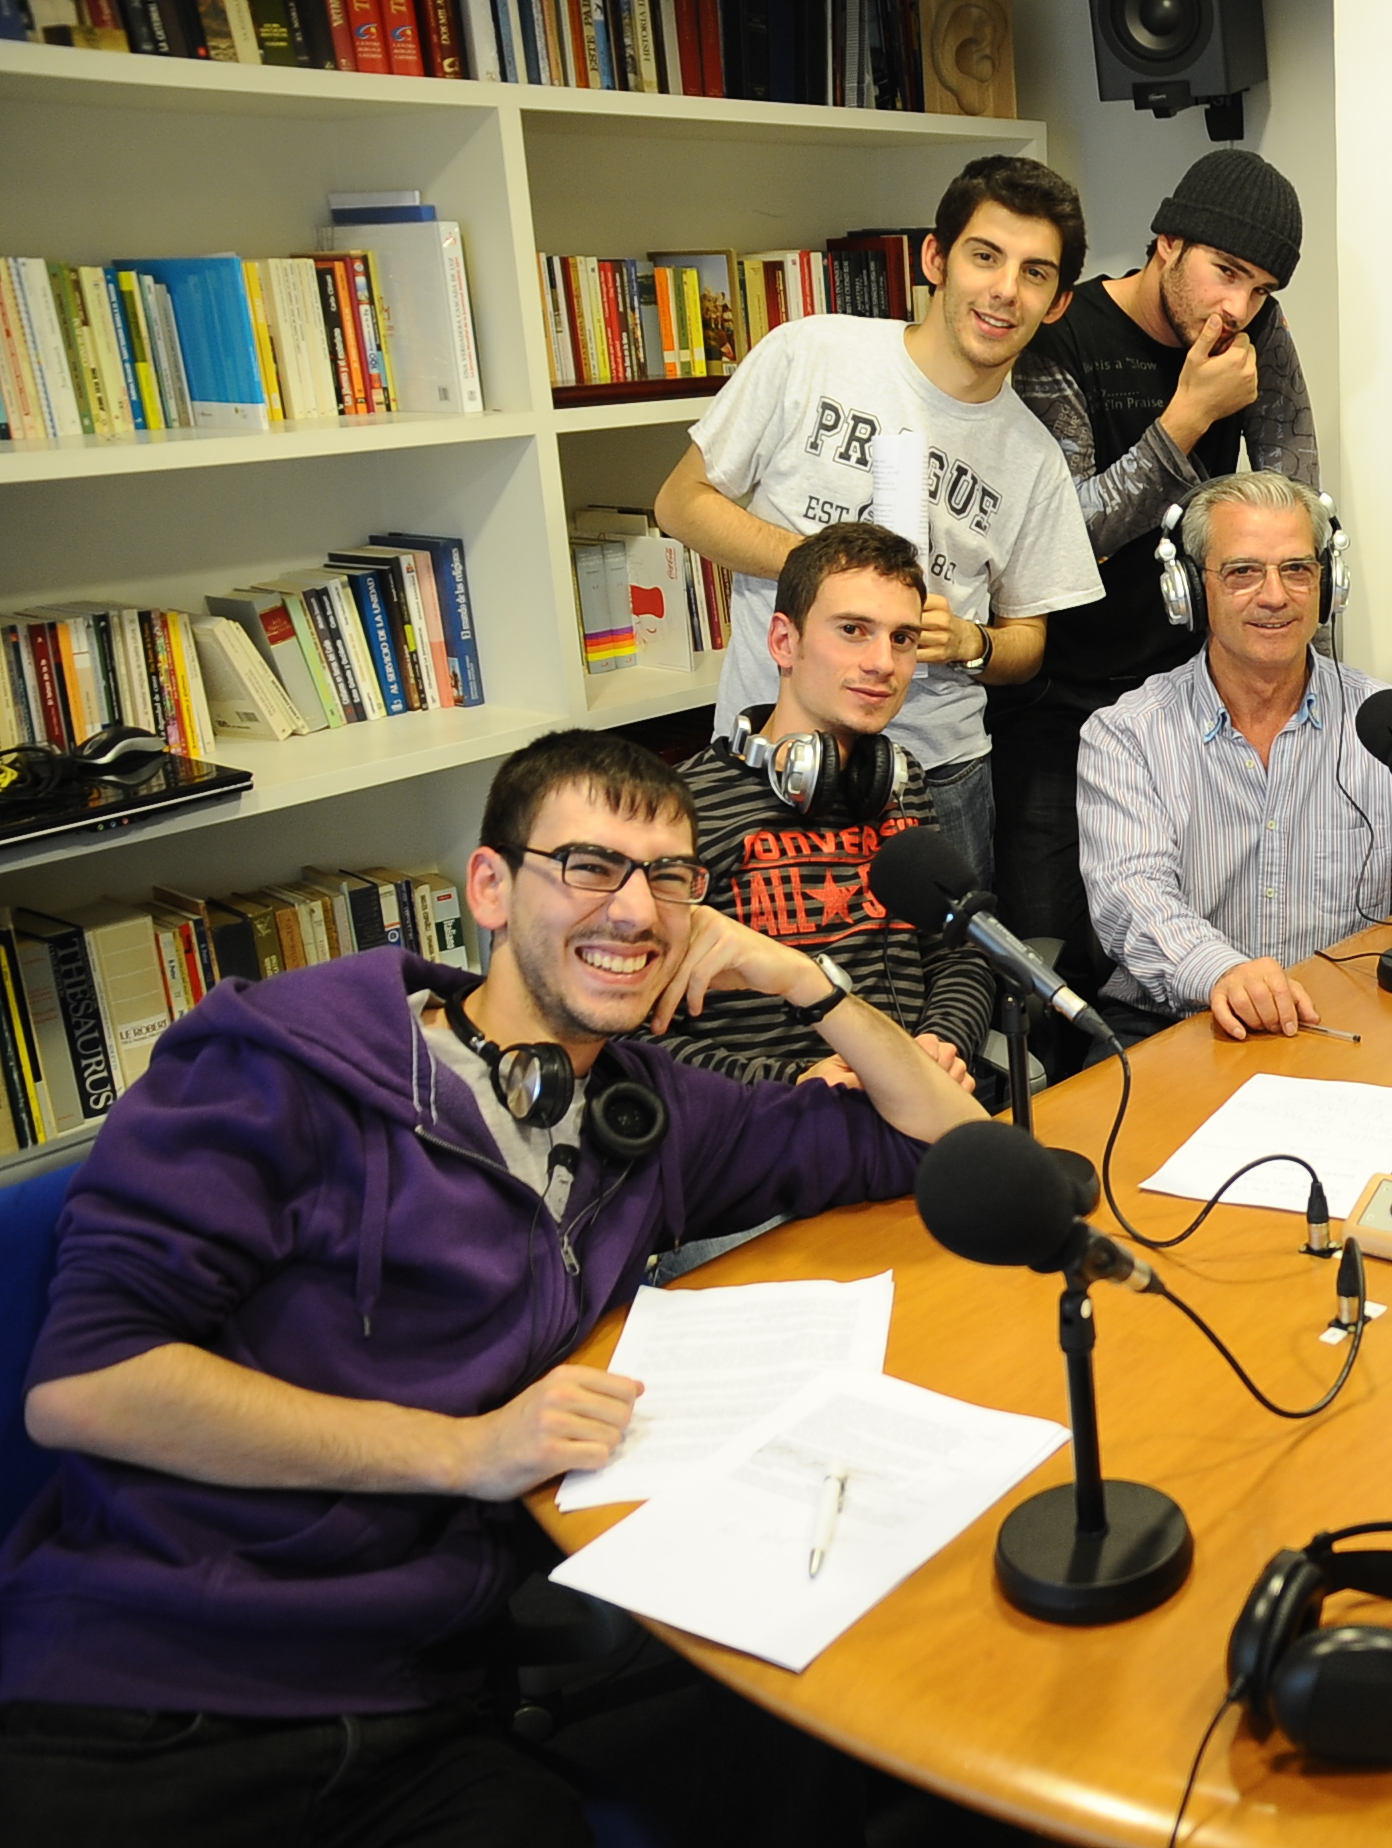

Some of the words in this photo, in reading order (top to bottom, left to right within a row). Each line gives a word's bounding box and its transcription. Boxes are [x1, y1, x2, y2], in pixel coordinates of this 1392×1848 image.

[586, 34, 598, 72] ESTE
[637, 11, 651, 62] HISTORIA
[451, 283, 460, 317] CASCADA
[456, 320, 466, 361] VERDADERA
[1127, 397, 1164, 409] Praise
[805, 396, 1003, 536] PRGUE
[366, 576, 380, 613] UNIDAD
[454, 582, 464, 594] las
[456, 594, 465, 603] de
[374, 614, 383, 627] LA
[377, 628, 386, 641] DE
[380, 641, 395, 682] SERVICIO
[389, 682, 398, 694] AL
[751, 866, 817, 936] ALL
[58, 937, 114, 1110] THESAURUS
[119, 1028, 131, 1041] LE
[133, 1018, 168, 1037] ROBERT
